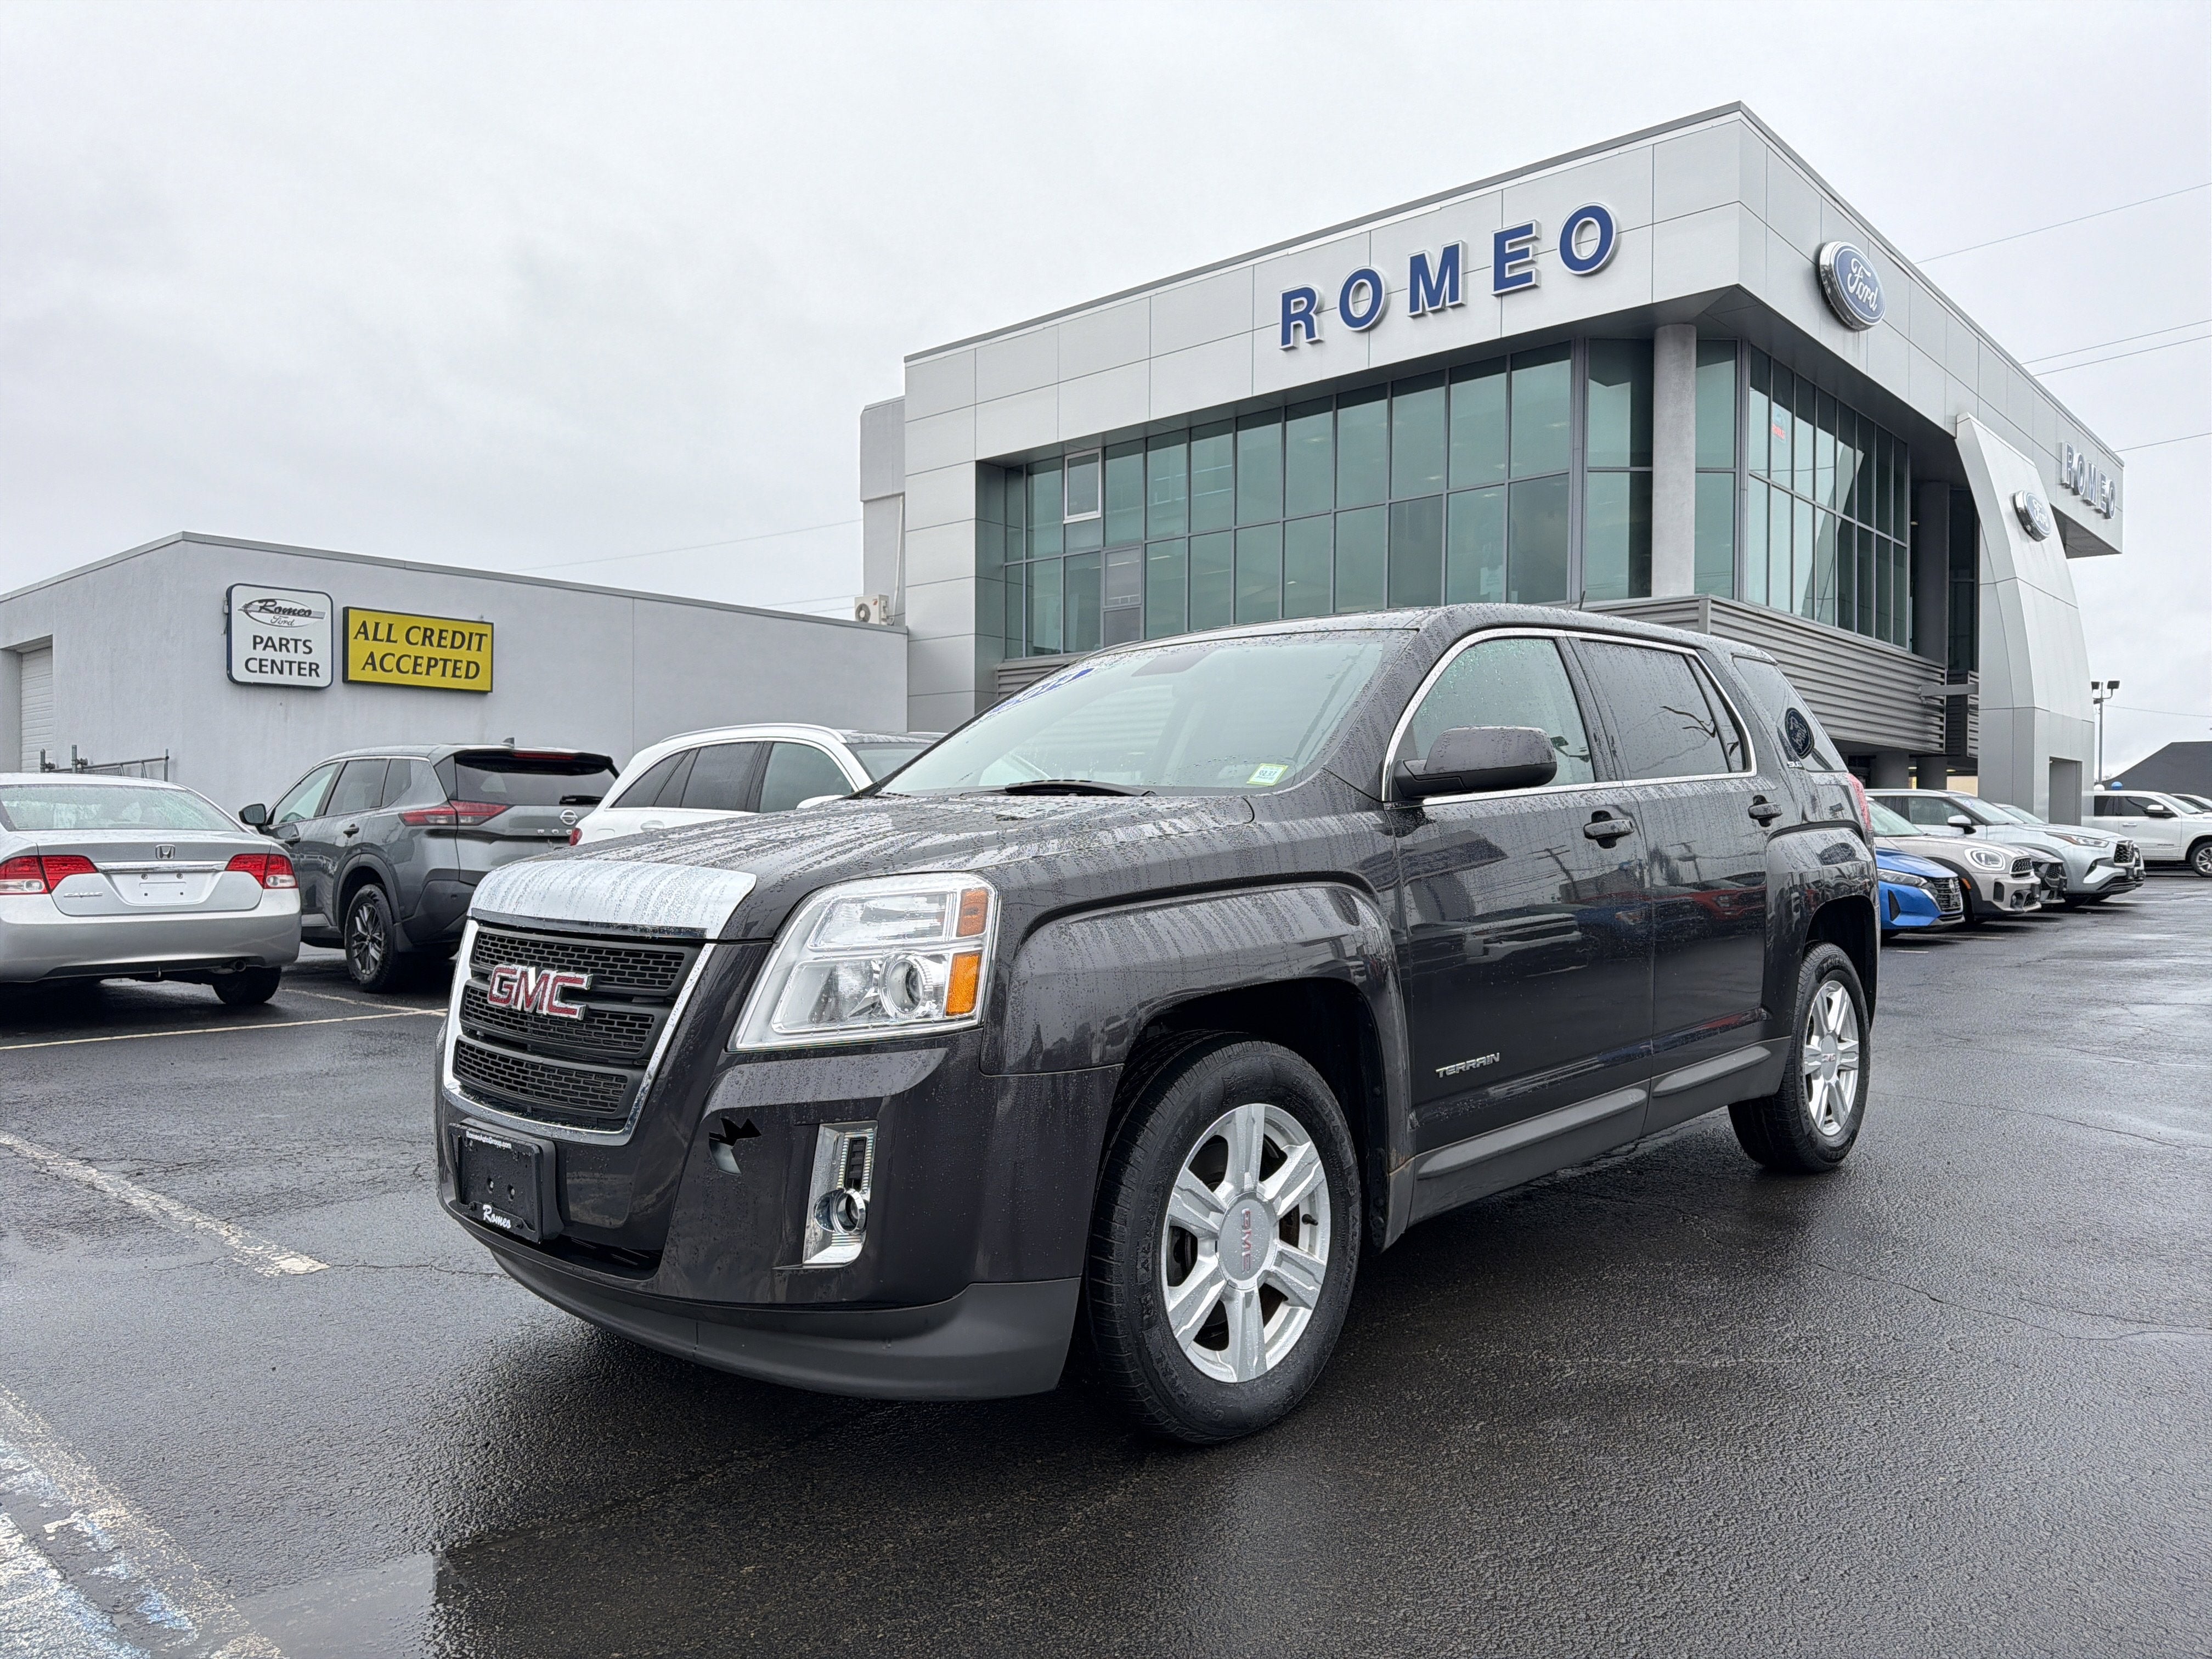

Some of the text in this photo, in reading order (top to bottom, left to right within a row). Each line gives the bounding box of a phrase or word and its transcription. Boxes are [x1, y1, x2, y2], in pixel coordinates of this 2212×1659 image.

[1280, 201, 1618, 350] ROMEO
[1847, 258, 1878, 312] Ford
[2063, 442, 2116, 518] ROMEO
[258, 599, 312, 617] Romeo
[270, 615, 295, 626] Ford
[252, 635, 313, 655] PARTS
[353, 620, 488, 652] ALL CREDIT
[244, 657, 320, 678] CENTER
[361, 651, 481, 680] ACCEPTED
[488, 963, 592, 1021] GMC
[1435, 1052, 1500, 1079] TERRAIN
[482, 1204, 511, 1229] Romeo
[1242, 1208, 1251, 1274] GMC
